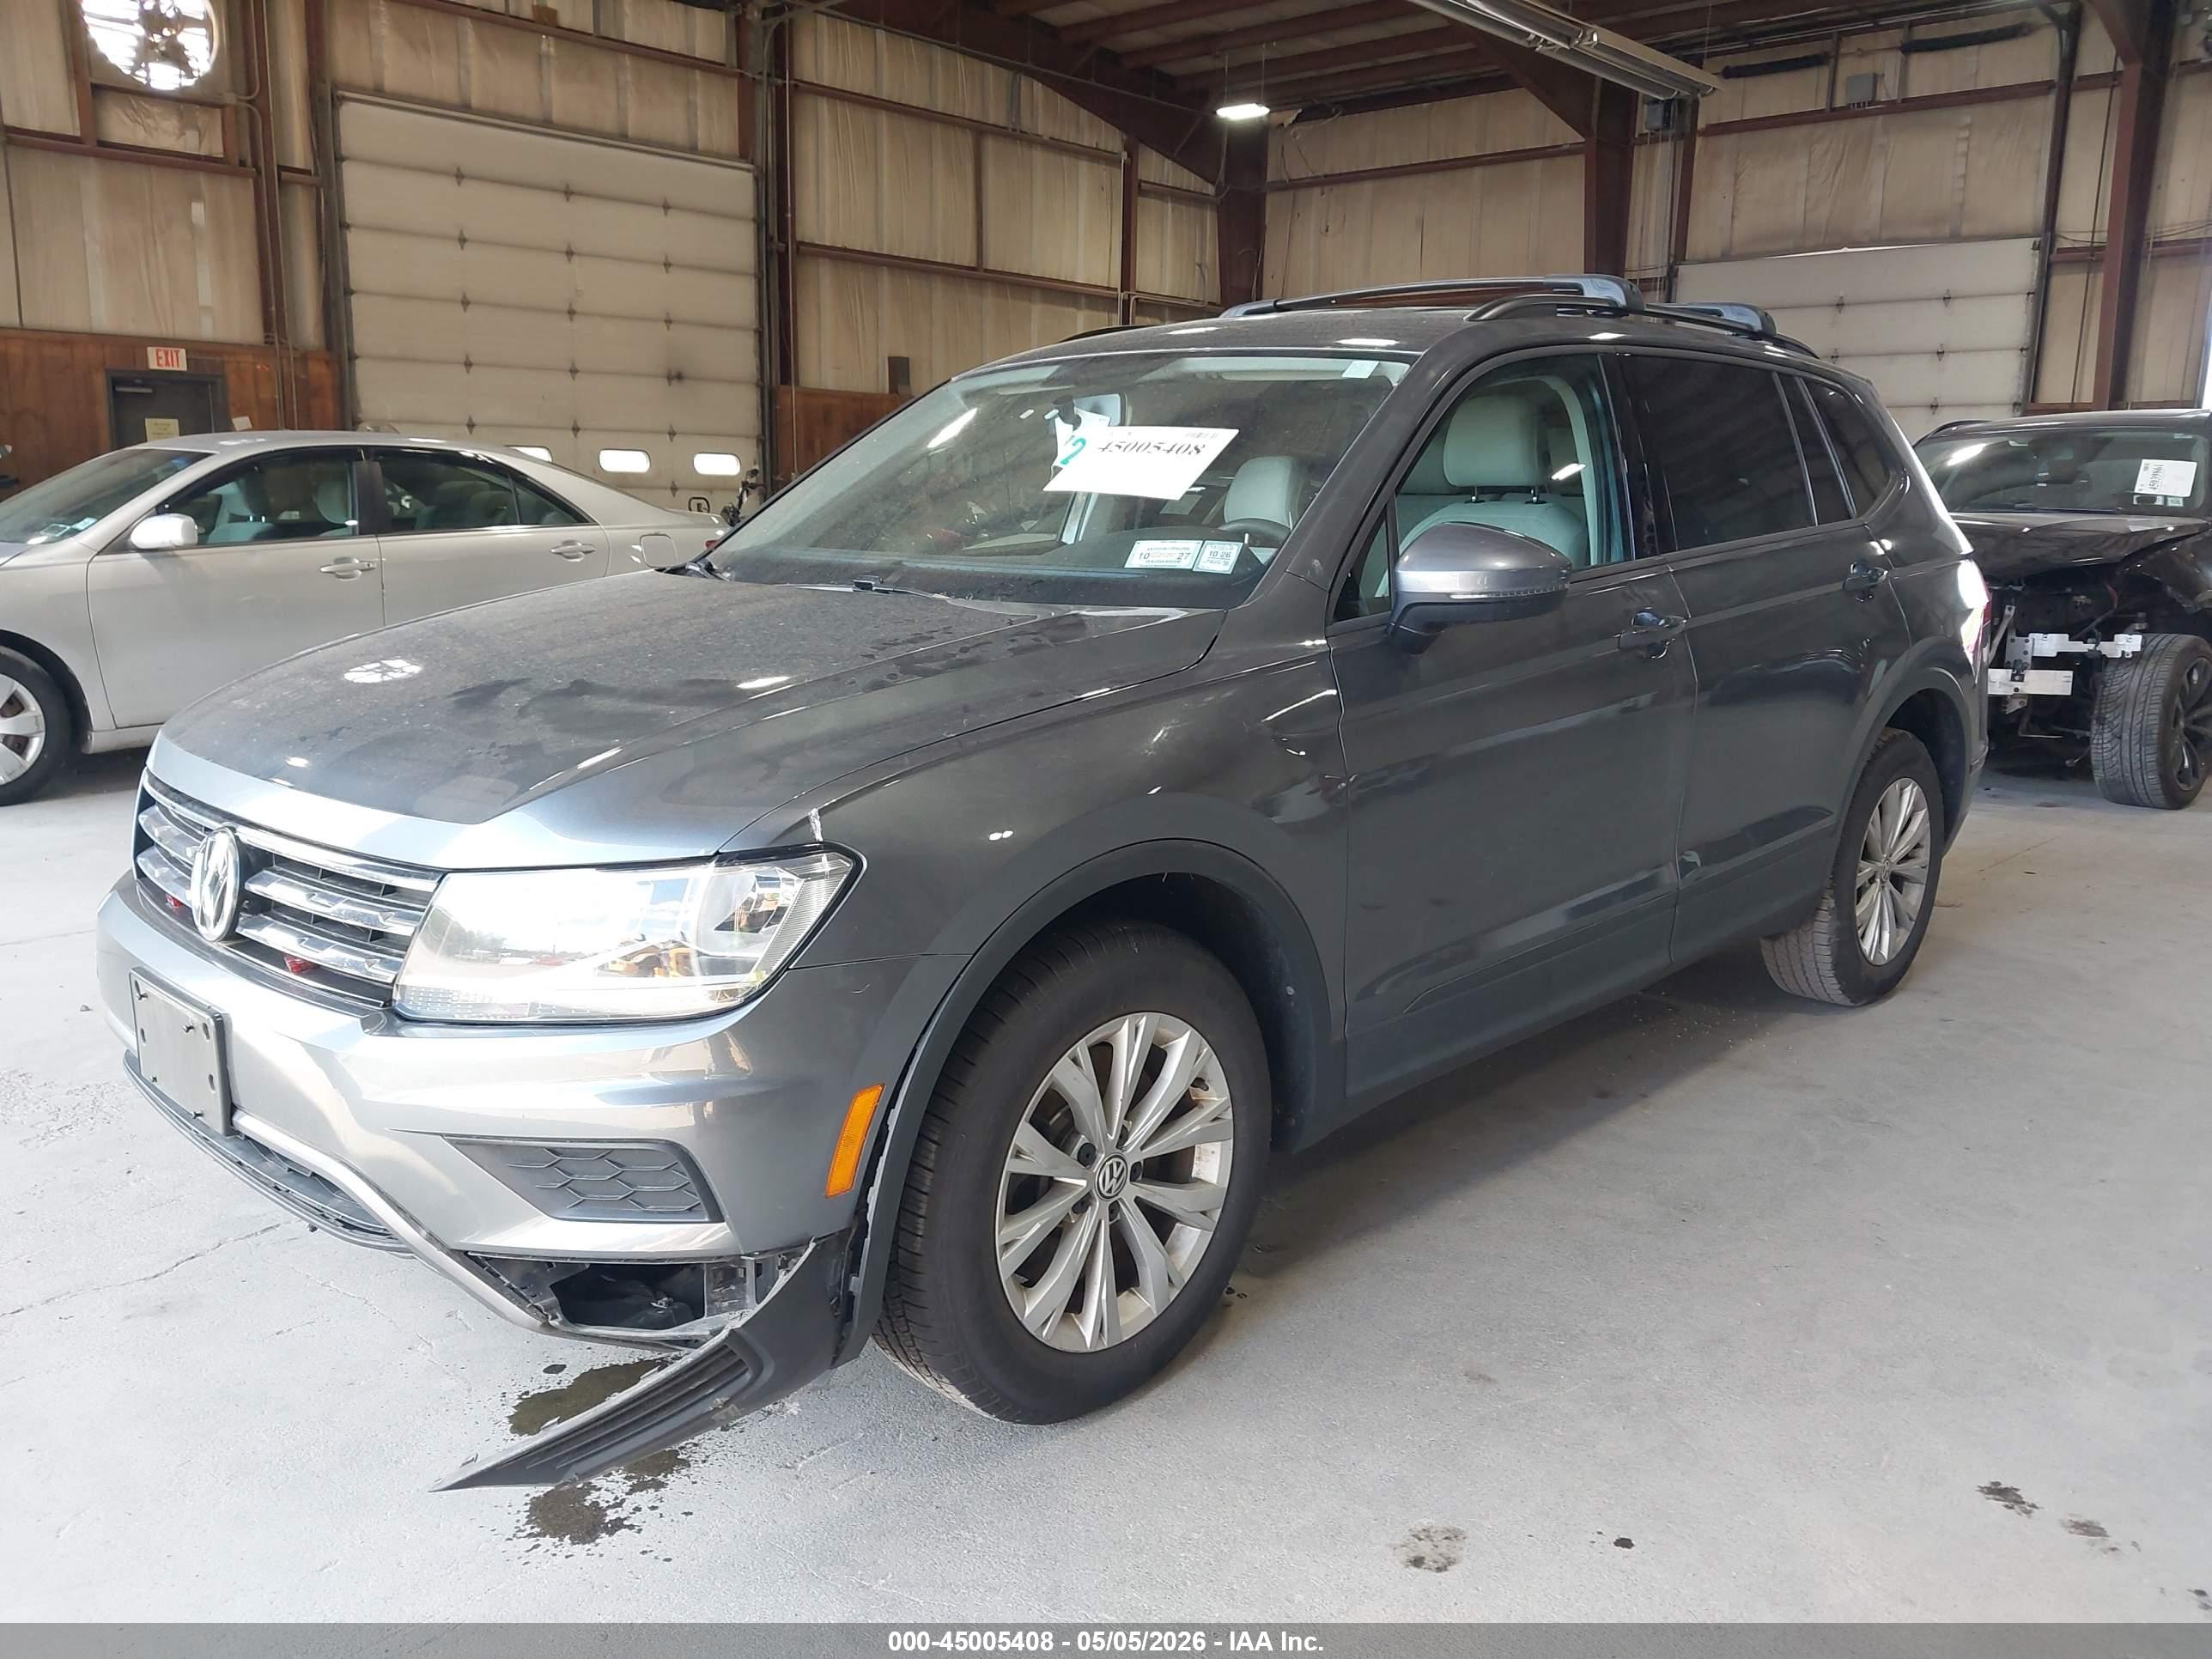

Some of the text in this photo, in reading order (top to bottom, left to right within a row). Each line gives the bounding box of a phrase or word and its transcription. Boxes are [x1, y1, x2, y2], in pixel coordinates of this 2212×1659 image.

[155, 349, 180, 368] EXIT
[1097, 441, 1206, 456] 45005408
[1098, 1156, 1127, 1199] VW
